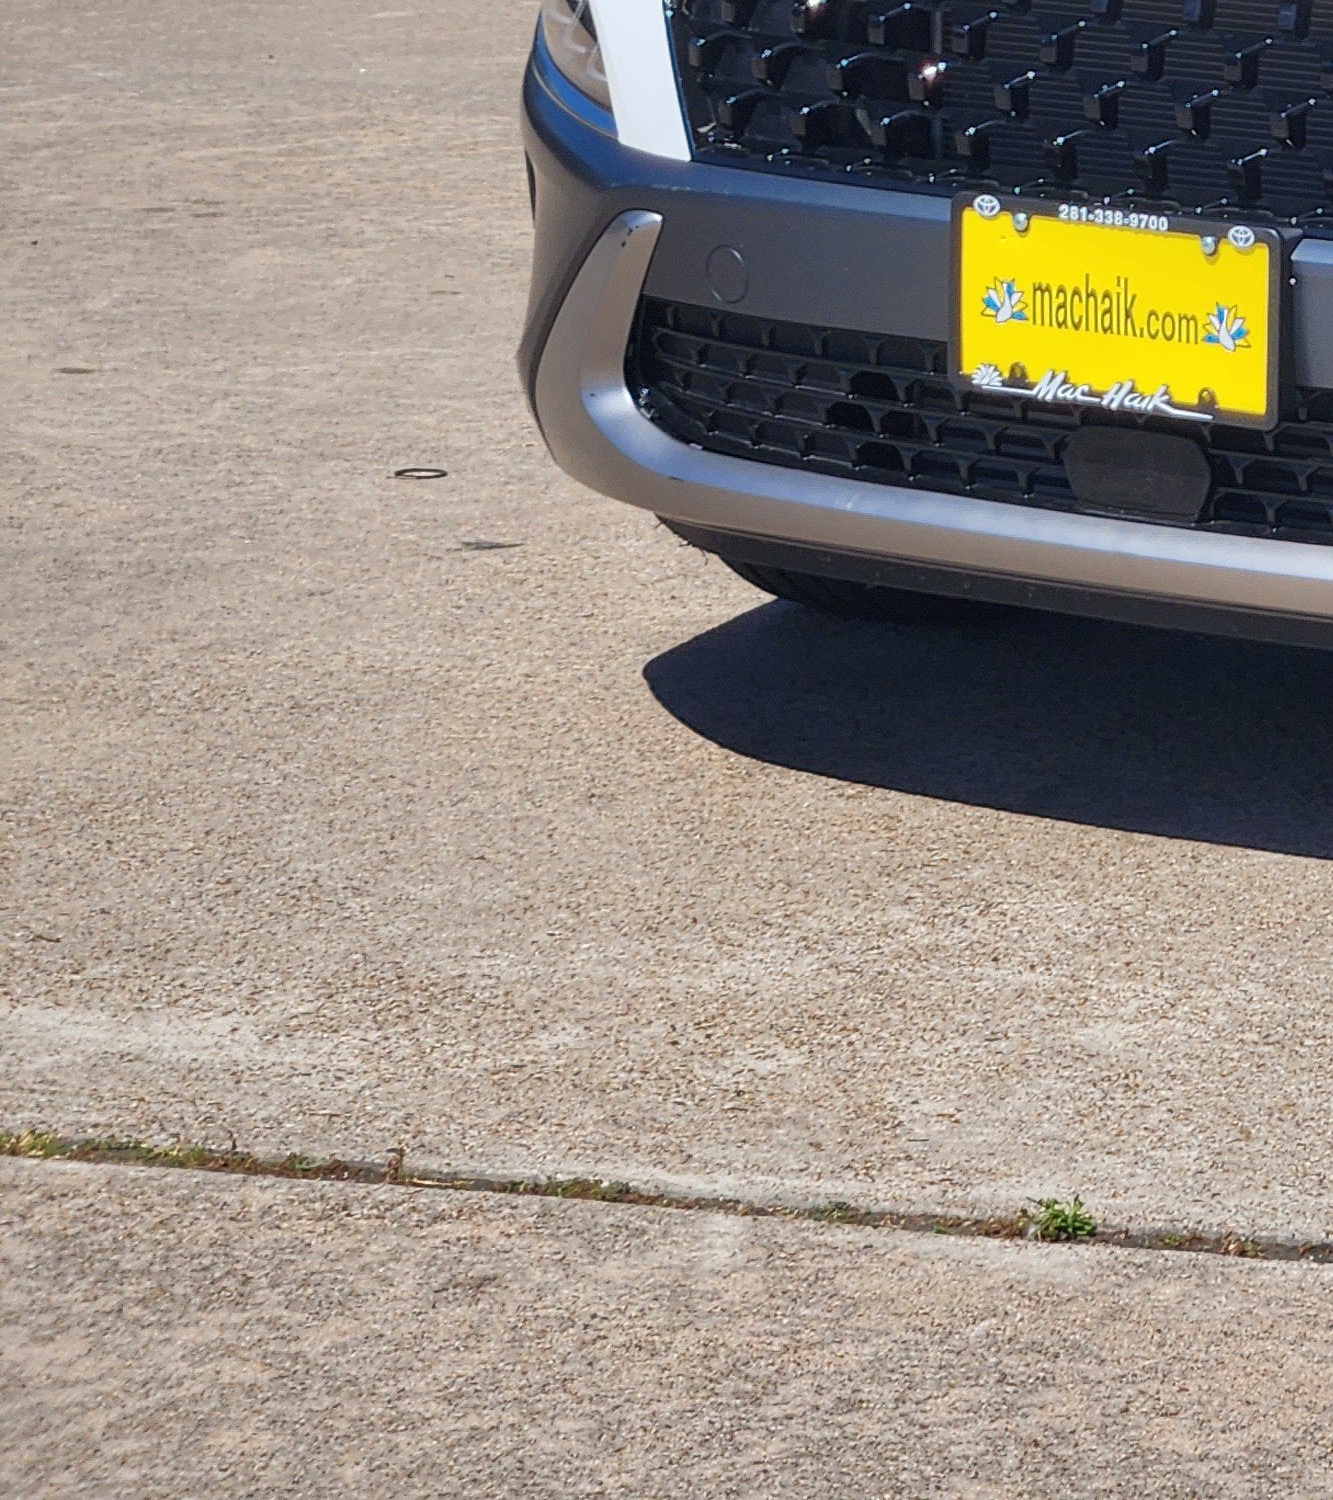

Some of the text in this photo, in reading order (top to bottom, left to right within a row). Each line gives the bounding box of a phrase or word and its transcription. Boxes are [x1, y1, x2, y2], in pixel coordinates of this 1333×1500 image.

[1058, 203, 1169, 232] 281-338-9700
[1031, 273, 1200, 346] machaik.com
[1032, 368, 1188, 416] Mac Haik
